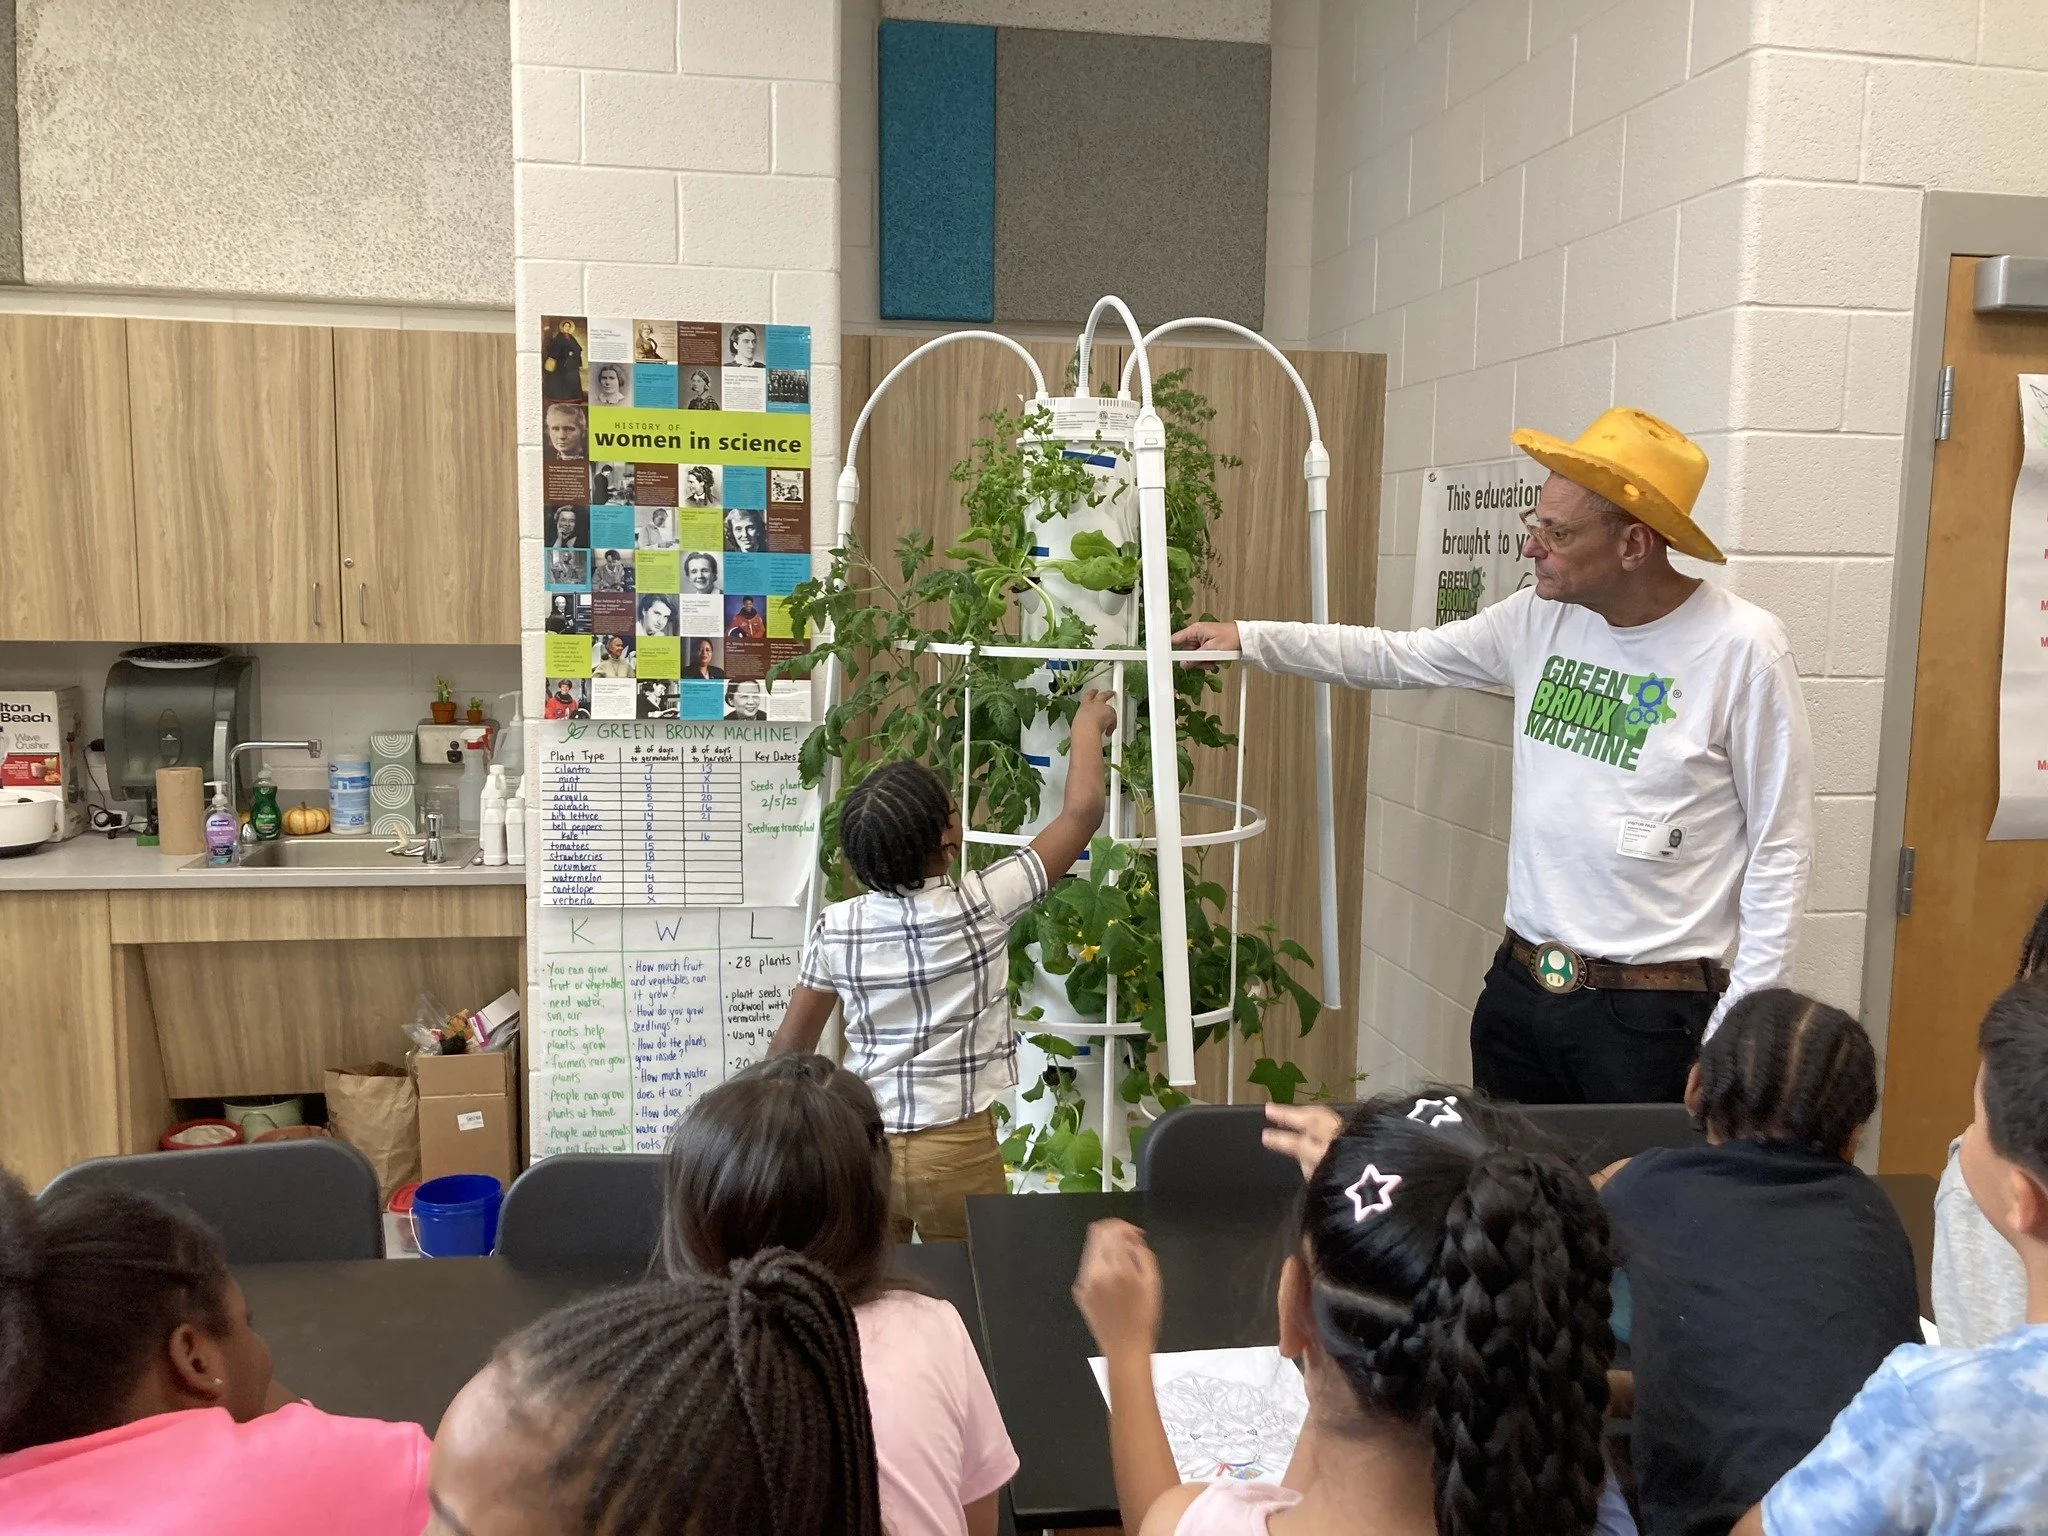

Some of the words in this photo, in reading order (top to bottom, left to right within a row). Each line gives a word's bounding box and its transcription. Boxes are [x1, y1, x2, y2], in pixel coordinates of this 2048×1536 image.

[615, 422, 661, 431] HISTORY
[595, 432, 681, 448] women
[690, 431, 710, 450] in
[719, 433, 802, 453] science
[1447, 484, 1471, 512] This
[1442, 527, 1491, 561] brought
[1498, 530, 1510, 555] to
[1439, 570, 1470, 588] GREEN
[1436, 587, 1471, 612] BRONX
[1542, 655, 1630, 699] GREEN
[1531, 677, 1623, 736] BRONX
[0, 712, 52, 723] Beach
[15, 733, 40, 741] Wave
[597, 722, 655, 739] GREEN
[666, 724, 715, 740] BRONX
[724, 726, 799, 744] MACHINE!
[15, 741, 50, 750] Crusher
[1524, 711, 1643, 772] MACHINE
[646, 745, 654, 753] of
[658, 745, 674, 754] days
[702, 745, 710, 754] of
[714, 745, 731, 754] days
[550, 751, 575, 761] Plant
[581, 750, 605, 763] Type
[703, 754, 734, 762] harvest
[755, 750, 770, 763] Key
[773, 750, 797, 761] Dates
[555, 764, 591, 774] cilantro
[645, 763, 653, 774] 7
[701, 763, 713, 774] 13
[558, 775, 580, 783] mint
[750, 780, 774, 791] Seeds
[560, 782, 578, 792] dill
[646, 793, 653, 801] 5
[701, 793, 713, 801] 20
[761, 794, 797, 811] 2/5/25
[647, 802, 654, 811] 5
[570, 812, 599, 821] lettuce
[644, 812, 654, 821] 14
[701, 812, 711, 821] 21
[552, 822, 567, 831] bell
[571, 823, 603, 835] peppers
[646, 822, 653, 831] 8
[747, 821, 781, 839] Seedlings
[550, 842, 590, 850] tomatoes
[644, 842, 655, 850] 15
[550, 851, 603, 861] strawberries
[645, 851, 655, 861] 18
[553, 862, 597, 871] cucumbers
[645, 862, 652, 871] 5
[552, 872, 602, 882] watermelon
[644, 873, 655, 882] 14
[647, 884, 654, 894] 8
[571, 916, 595, 944] K
[655, 916, 682, 942] W
[750, 911, 774, 939] L
[636, 960, 654, 972] How
[658, 958, 680, 972] much
[683, 957, 704, 971] fruit
[735, 955, 752, 969] 28
[759, 954, 791, 974] plants
[547, 962, 565, 976] You
[569, 966, 584, 975] can
[588, 965, 608, 980] grow
[548, 978, 570, 991] fruit
[630, 975, 646, 986] and
[648, 974, 690, 992] vegetables
[692, 975, 707, 983] can
[633, 989, 643, 1000] it
[731, 988, 754, 1003] plant
[759, 985, 781, 998] seeds
[549, 995, 571, 1008] need
[729, 1001, 764, 1012] rockwool
[768, 1000, 788, 1010] with
[568, 1012, 583, 1020] air
[636, 1004, 654, 1017] How
[657, 1004, 667, 1015] do
[669, 1008, 683, 1020] you
[685, 1006, 704, 1023] grow
[551, 1026, 579, 1037] roots
[585, 1024, 605, 1040] help
[758, 1027, 764, 1037] 4
[547, 1040, 576, 1055] plants
[582, 1040, 606, 1056] grow
[637, 1037, 654, 1051] How
[657, 1037, 667, 1049] do
[670, 1037, 682, 1048] the
[685, 1034, 707, 1053] plants
[552, 1054, 587, 1069] farmers
[590, 1058, 606, 1067] can
[635, 1055, 652, 1070] grow
[735, 1057, 750, 1070] 20
[552, 1073, 581, 1086] plants
[641, 1068, 658, 1083] How
[661, 1067, 682, 1081] much
[684, 1067, 708, 1079] water
[550, 1088, 580, 1105] People
[584, 1092, 599, 1101] can
[601, 1090, 625, 1107] grow
[636, 1088, 655, 1099] does
[658, 1086, 667, 1098] it
[547, 1108, 575, 1122] plants
[577, 1108, 588, 1118] at
[591, 1106, 616, 1117] home
[641, 1105, 659, 1118] How
[663, 1104, 680, 1117] does
[582, 1125, 597, 1138] and
[636, 1123, 658, 1134] water
